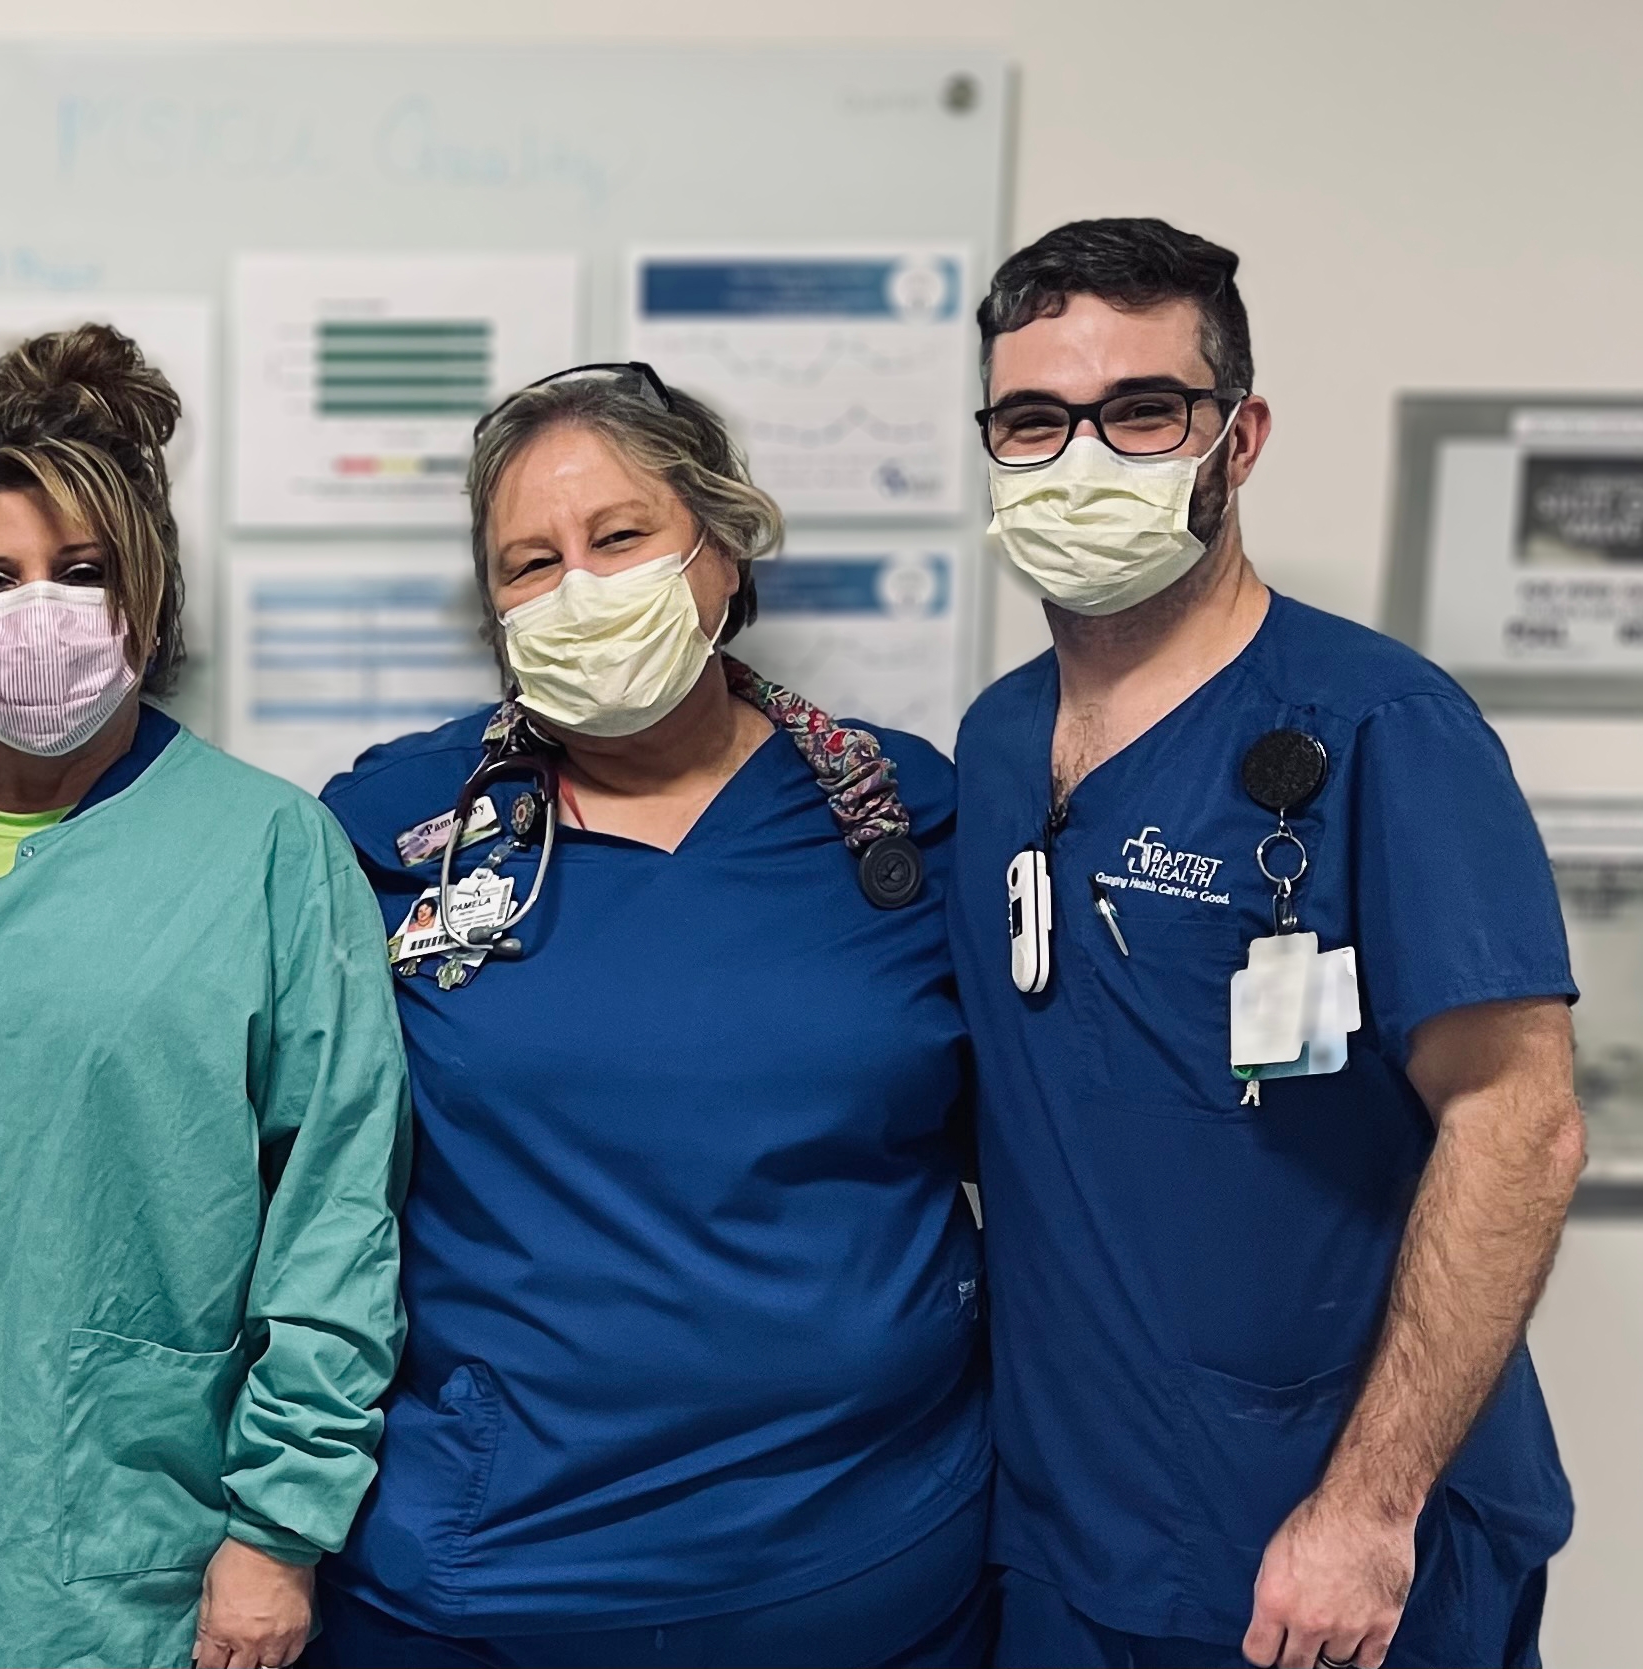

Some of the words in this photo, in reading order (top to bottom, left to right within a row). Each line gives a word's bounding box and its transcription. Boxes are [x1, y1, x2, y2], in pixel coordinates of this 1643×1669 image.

[1151, 849, 1224, 875] BAPTIST
[1149, 862, 1214, 888] HEALTH
[1128, 876, 1157, 892] Health
[1158, 882, 1181, 897] Care
[1180, 886, 1198, 900] for
[450, 897, 491, 913] PAMELA
